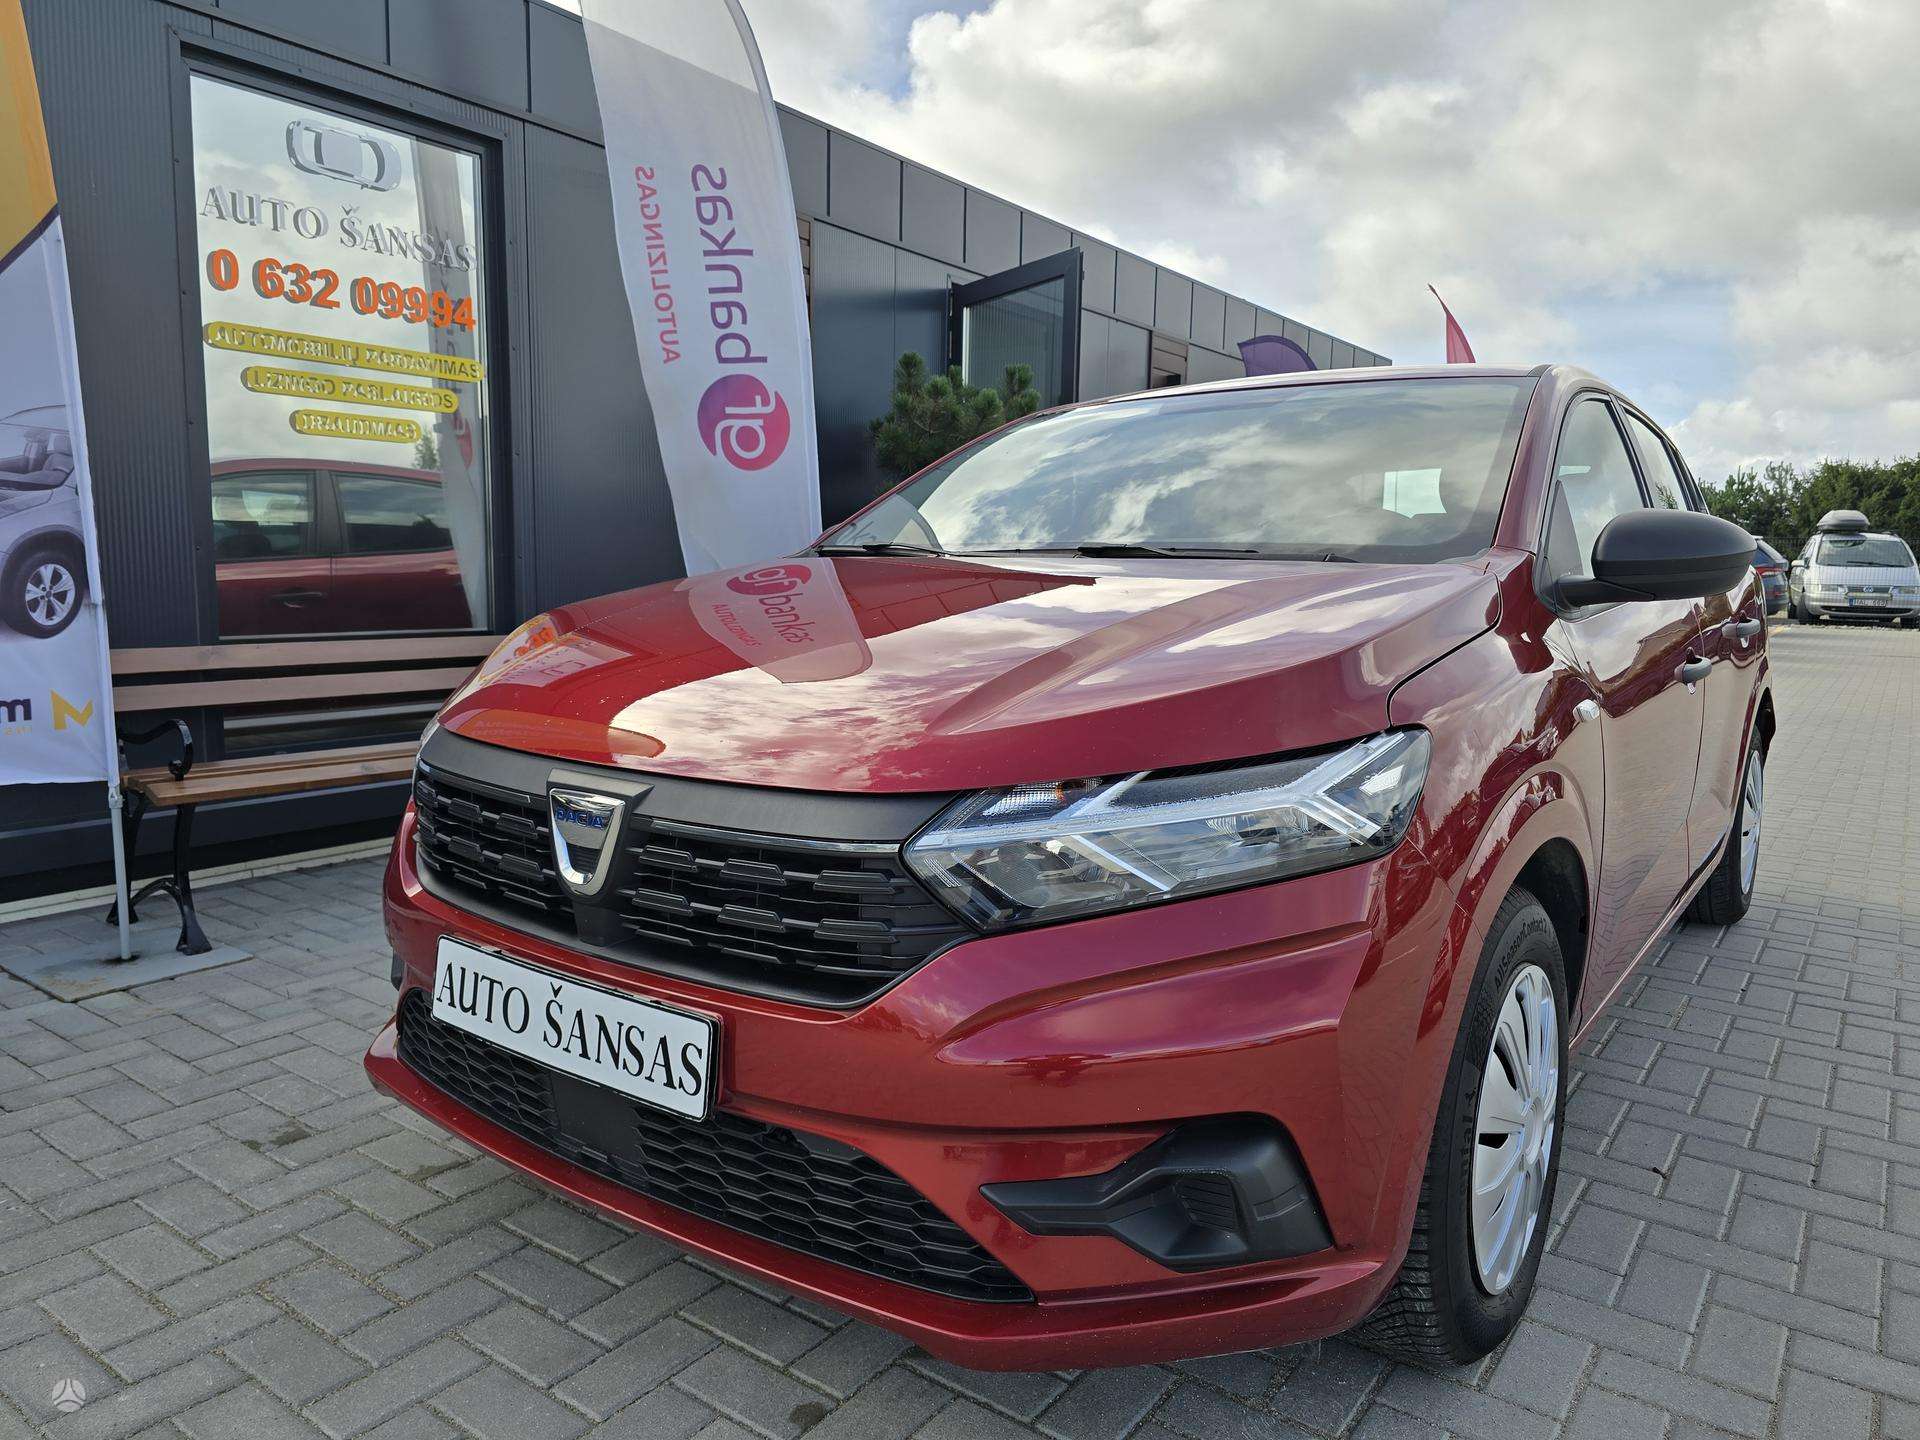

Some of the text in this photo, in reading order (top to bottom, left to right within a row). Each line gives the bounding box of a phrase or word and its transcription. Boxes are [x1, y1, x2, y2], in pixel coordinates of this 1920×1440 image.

[200, 185, 478, 273] AUTO ŠANSAS
[207, 248, 477, 332] 0 632 09994
[556, 807, 605, 832] DACIA
[436, 961, 703, 1097] AUTO ŠANSAS
